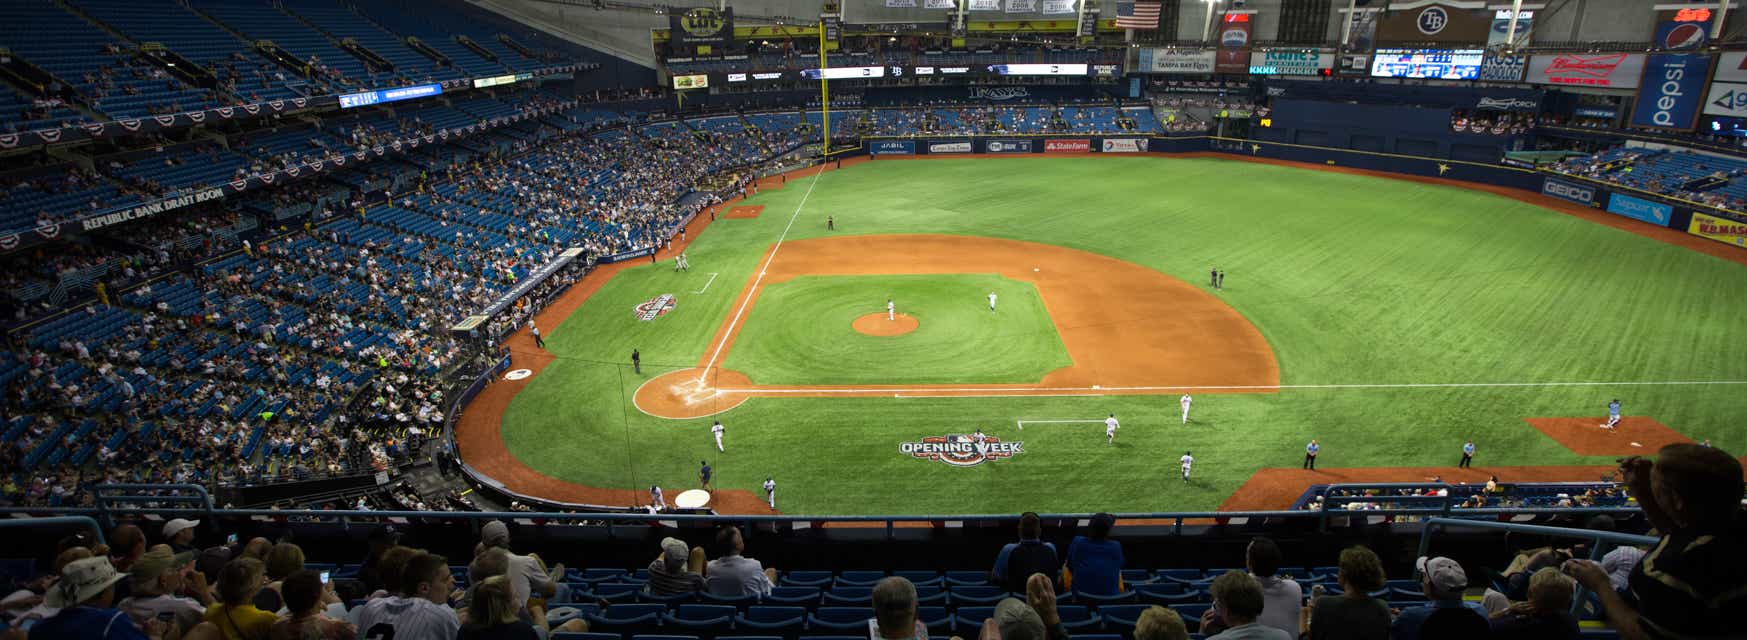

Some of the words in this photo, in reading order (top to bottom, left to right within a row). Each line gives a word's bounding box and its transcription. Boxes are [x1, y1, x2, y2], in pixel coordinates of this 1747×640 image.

[1653, 63, 1686, 126] pepsi
[1544, 182, 1592, 202] GEICO
[82, 210, 136, 231] REPUBLIC
[135, 203, 164, 218] BANK
[165, 195, 196, 210] DRAFT
[196, 188, 224, 202] ROOM
[1719, 224, 1747, 236] MAS
[901, 442, 973, 453] OPENING
[974, 441, 1025, 453] WEEK
